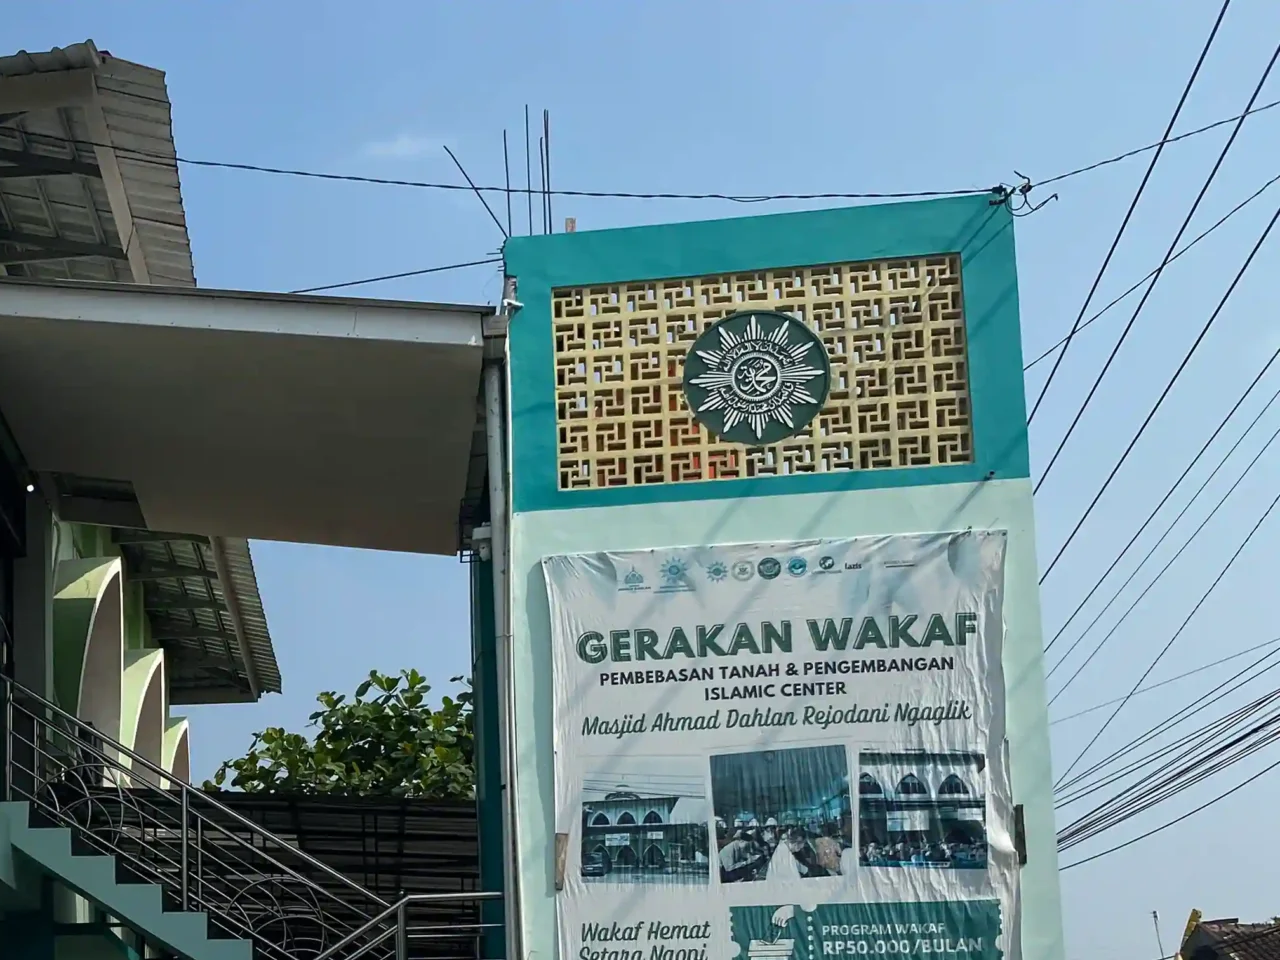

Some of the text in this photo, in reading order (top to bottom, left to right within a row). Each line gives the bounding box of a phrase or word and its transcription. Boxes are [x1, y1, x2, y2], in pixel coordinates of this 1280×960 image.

[575, 612, 978, 664] GERAKAN WAKAF
[599, 656, 954, 687] PEMBEBASAN TANAH & PENGEMBANGAN
[704, 681, 847, 701] ISLAMIC CENTER
[581, 700, 972, 738] Masjid Ahmad Dahlan Rejodani Ngaglik
[581, 919, 711, 943] Wakaf Hemat
[822, 922, 945, 936] PROGRAM WAKAF
[823, 937, 982, 955] RP50.000/BULAN
